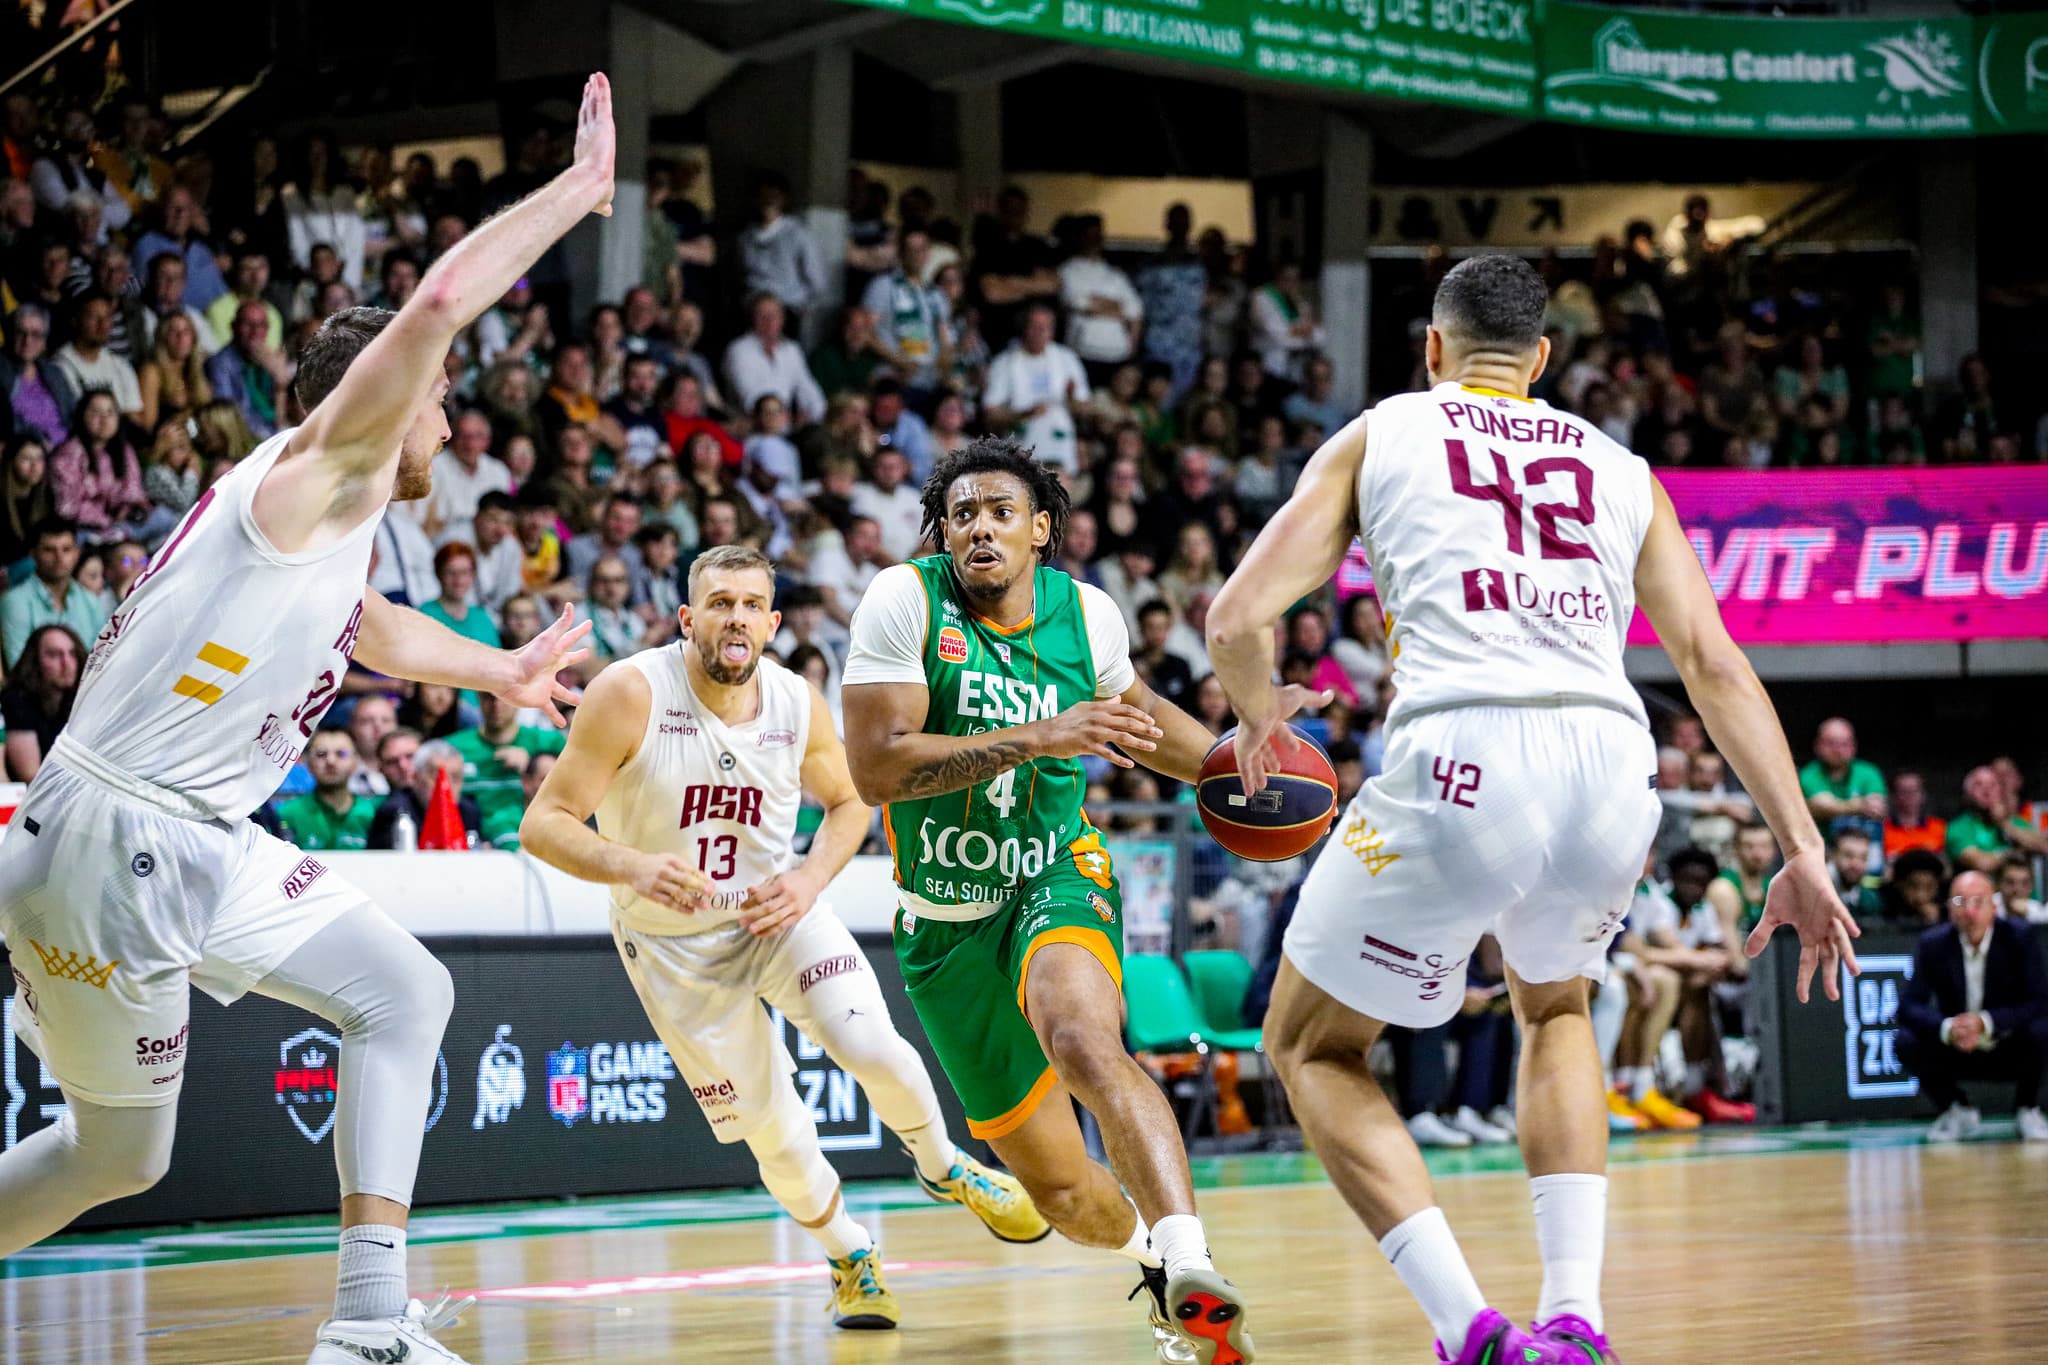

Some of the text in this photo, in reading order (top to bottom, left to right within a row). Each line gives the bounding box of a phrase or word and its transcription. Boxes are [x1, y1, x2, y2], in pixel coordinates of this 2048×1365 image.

[1732, 49, 1856, 82] Confort
[1439, 402, 1585, 448] PONSAR
[1443, 438, 1603, 566] 42
[939, 643, 967, 657] KING
[940, 635, 967, 648] BURGER
[957, 670, 1059, 724] ESSM
[985, 767, 1017, 819] 4
[1433, 755, 1483, 809] 42
[680, 784, 763, 830] ASA
[697, 834, 738, 880] 13
[925, 876, 956, 899] SEA
[590, 1041, 676, 1081] GAME
[590, 1081, 668, 1124] PASS
